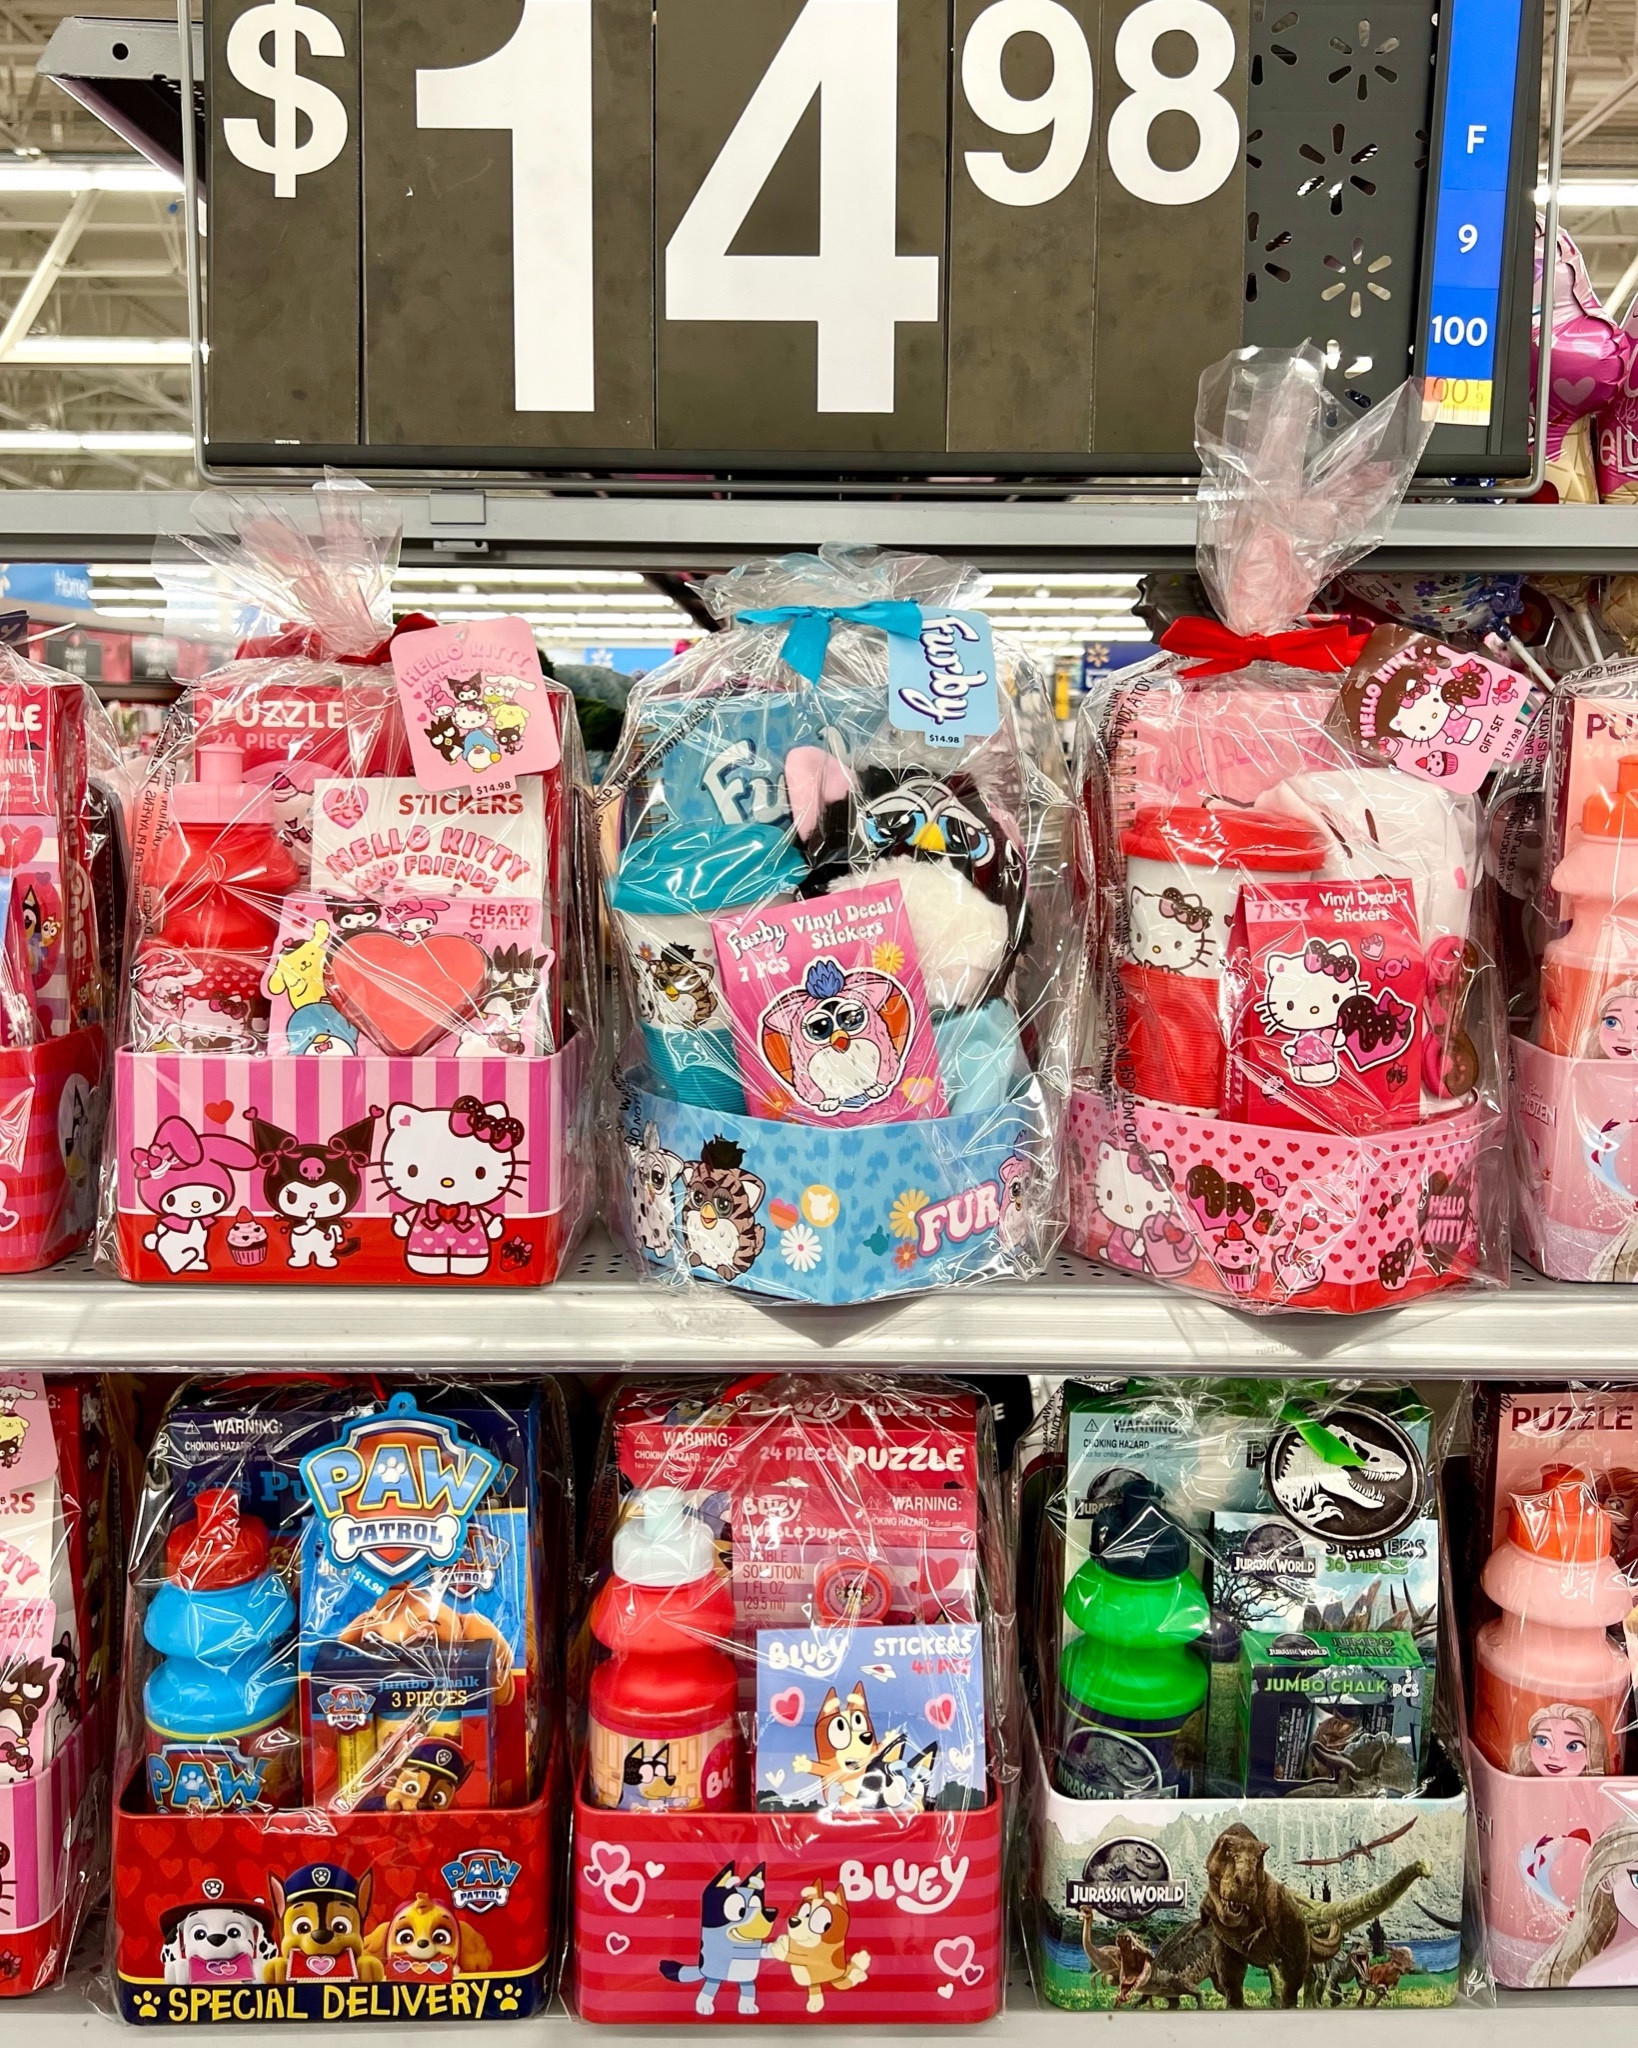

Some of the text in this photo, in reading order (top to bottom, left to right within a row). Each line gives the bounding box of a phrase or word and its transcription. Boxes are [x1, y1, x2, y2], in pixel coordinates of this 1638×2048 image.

[1466, 125, 1487, 154] F
[1457, 223, 1478, 254] 9
[1431, 315, 1488, 347] 100
[401, 644, 464, 688] HELLO
[1360, 645, 1418, 738] HELLO KITTY
[213, 699, 345, 729] PUZZLE
[245, 733, 316, 750] PIECES
[929, 734, 960, 744] $14.98
[1479, 714, 1505, 754] GIFT SET
[1501, 728, 1523, 760] $17.98
[1534, 753, 1546, 777] BAG
[1541, 717, 1550, 740] NOT
[476, 781, 512, 795] $14.98
[399, 793, 524, 815] STICKERS
[326, 824, 431, 881] HELLO
[440, 826, 531, 883] KITTY
[404, 855, 499, 895] FRIENDS
[472, 903, 530, 917] HEART
[1319, 891, 1355, 908] Vinyl
[790, 896, 894, 934] Vinyl Decal
[1255, 902, 1303, 920] 7 PCS
[1334, 907, 1389, 923] Stickers
[470, 917, 531, 931] CHALK
[810, 920, 885, 950] Stickers
[726, 919, 789, 961] Furby
[755, 955, 791, 980] PCS
[1116, 1047, 1133, 1066] IN
[1119, 1066, 1138, 1092] USE
[1122, 1092, 1136, 1121] NOT
[1123, 1124, 1138, 1143] DO
[1428, 1195, 1465, 1217] HELLO
[917, 1182, 1001, 1256] FUR
[1423, 1219, 1465, 1244] KITTY
[213, 1419, 284, 1435] WARNING:
[1051, 1415, 1063, 1440] NOT
[1511, 1405, 1635, 1432] PUZZLE
[184, 1441, 220, 1452] CHOKING
[663, 1431, 733, 1448] WARNING:
[1119, 1440, 1150, 1449] HAZARD
[1508, 1434, 1530, 1450] 24
[760, 1446, 966, 1472] 24 PIECE PUZZLE
[307, 1443, 493, 1519] PAW
[742, 1495, 803, 1523] BLUEY
[892, 1496, 962, 1511] WARNING:
[898, 1517, 929, 1528] HAZARD
[348, 1521, 444, 1547] PATROL
[1234, 1556, 1315, 1574] JURASSIC WORLD
[1325, 1557, 1408, 1575] 36 PIECES
[1346, 1548, 1382, 1562] $14.98
[353, 1570, 386, 1596] $14.98
[744, 1581, 749, 1594] 1
[753, 1582, 767, 1595] FL
[743, 1596, 786, 1611] (29.5 ml)
[1269, 1648, 1328, 1657] JURASSIC WORLD
[1331, 1636, 1394, 1647] JUMBO
[1336, 1647, 1397, 1658] CHALK
[769, 1634, 977, 1678] BLUEY STICKERS
[378, 1675, 480, 1693] Jumbo Chalk
[1264, 1677, 1388, 1693] JUMBO CHALK
[1404, 1669, 1412, 1684] 3
[392, 1689, 468, 1708] 3 PIECES
[1392, 1682, 1420, 1698] PCS
[316, 1691, 377, 1714] PAW
[148, 1753, 271, 1810] PAW
[441, 1859, 522, 1891] PAW
[840, 1855, 969, 1914] BLUEY
[460, 1890, 502, 1900] PATROL
[1070, 1884, 1185, 1905] JURASSIC WORLD
[168, 1979, 491, 2022] SPECIAL DELIVERY
